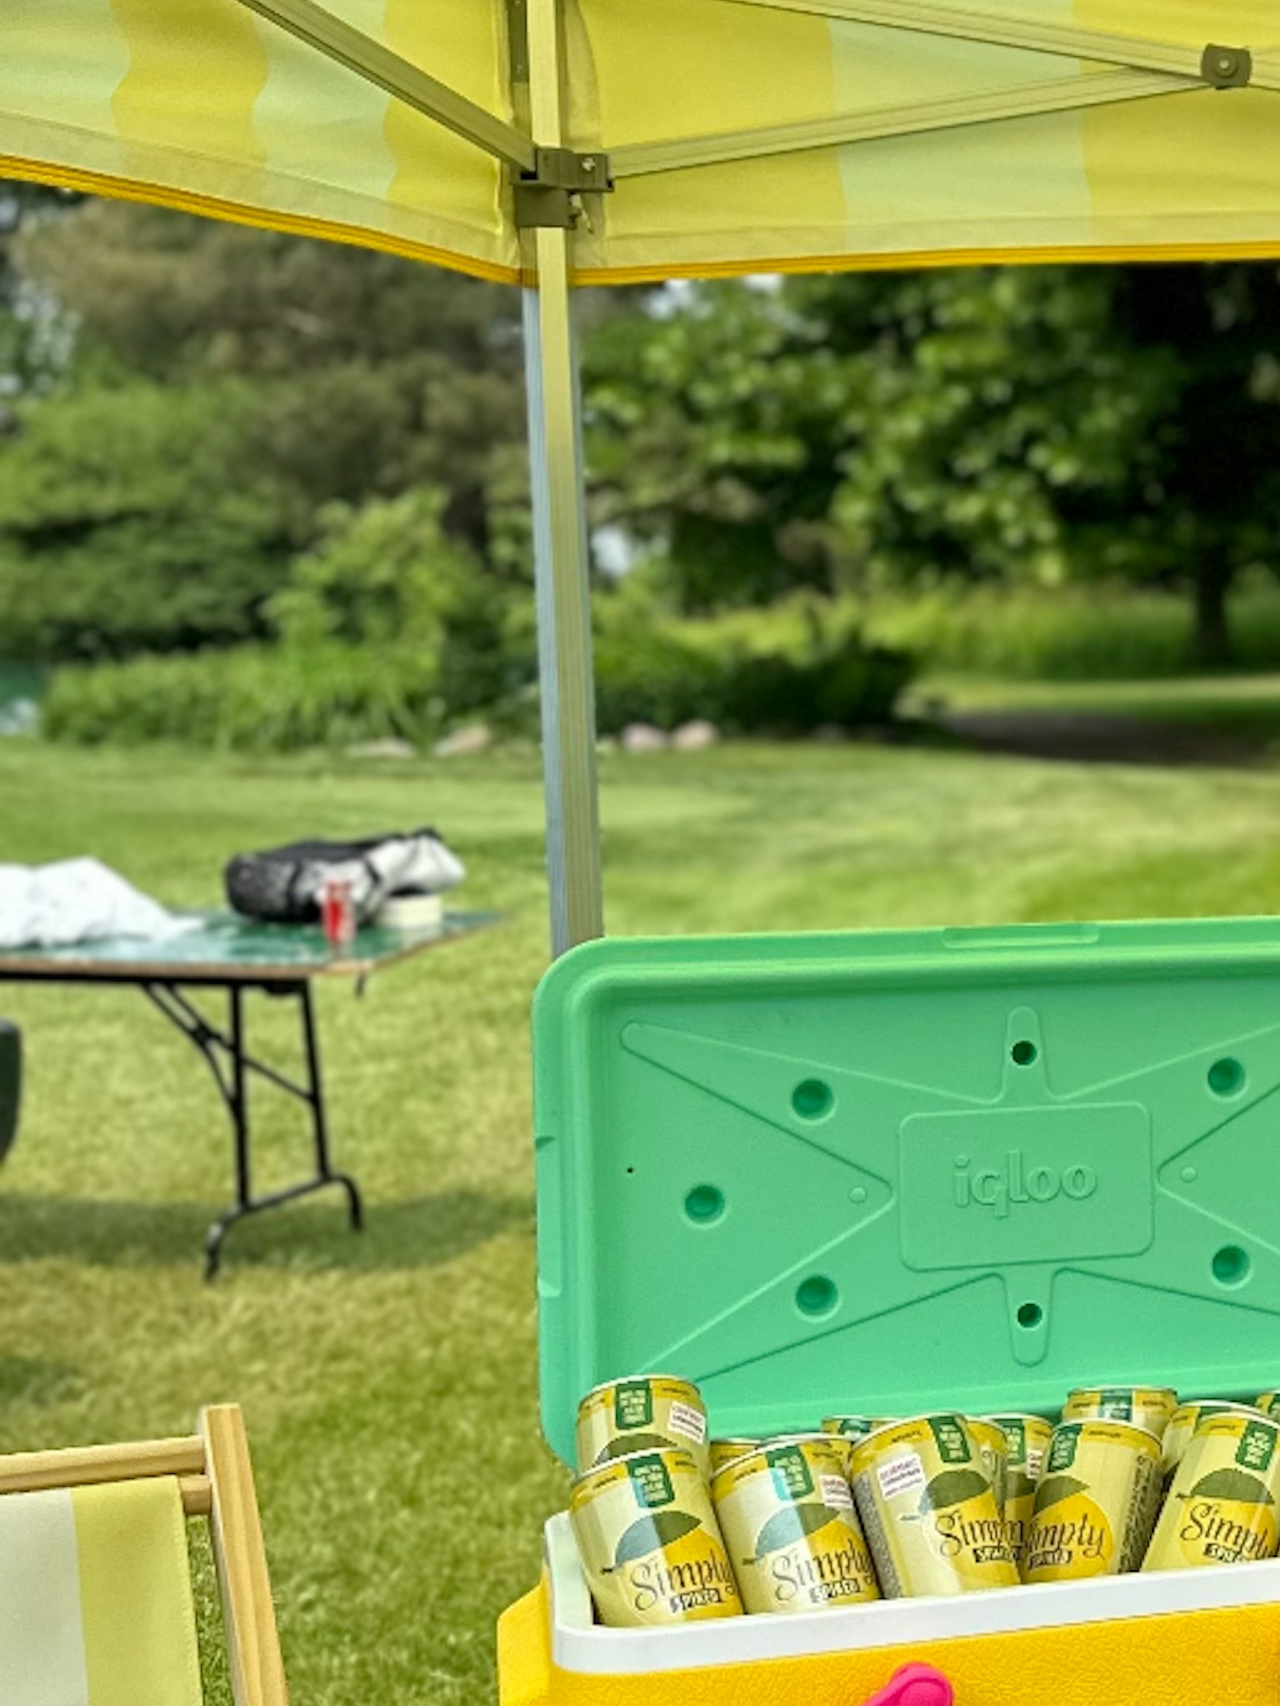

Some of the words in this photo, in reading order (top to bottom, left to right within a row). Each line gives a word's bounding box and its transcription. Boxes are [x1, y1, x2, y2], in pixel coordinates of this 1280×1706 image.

[954, 1150, 1097, 1218] igloo
[631, 1548, 736, 1611] Simply
[772, 1537, 875, 1602] Simply
